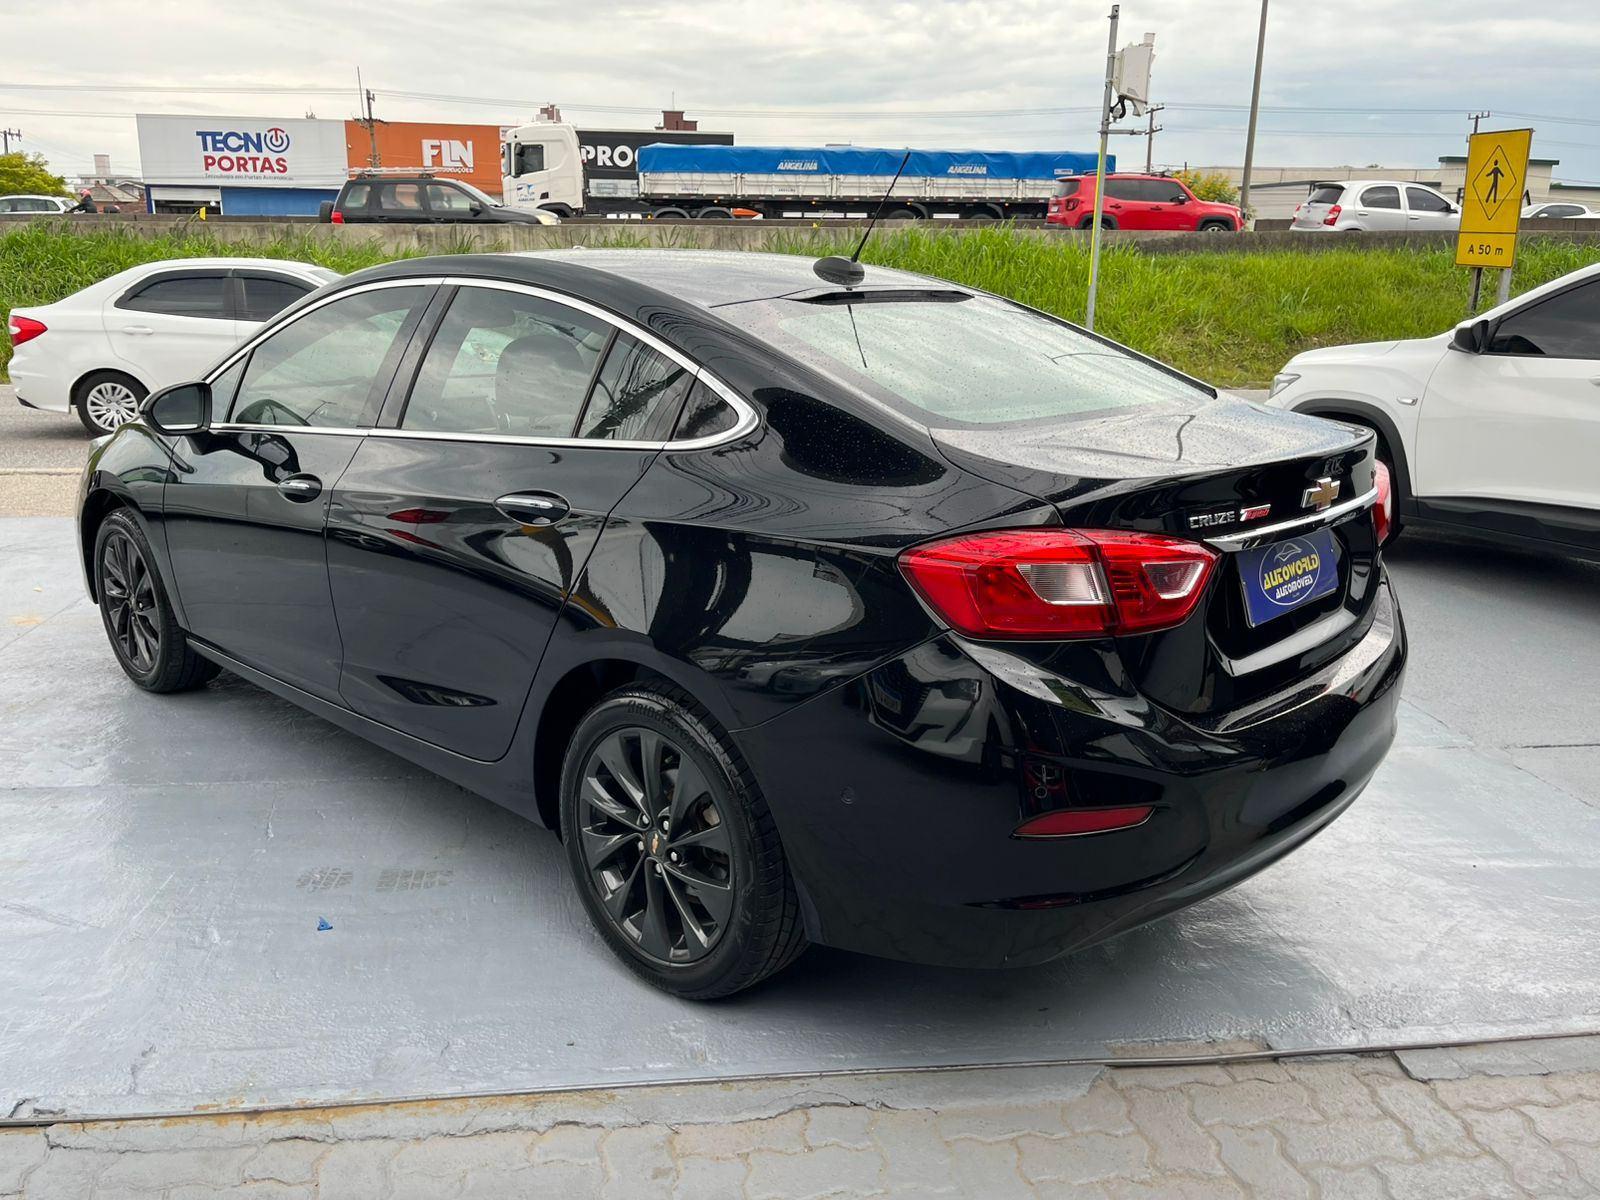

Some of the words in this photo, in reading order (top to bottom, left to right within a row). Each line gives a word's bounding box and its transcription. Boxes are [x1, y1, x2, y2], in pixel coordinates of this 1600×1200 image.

[204, 155, 288, 173] PORTAS
[580, 145, 639, 167] PRO
[777, 161, 818, 171] ANGELINA
[947, 165, 987, 174] ANGELINA
[1468, 244, 1475, 255] A
[1478, 244, 1492, 255] 50
[1494, 247, 1504, 256] m
[1189, 510, 1236, 529] CRUZE
[1264, 553, 1319, 590] AUTOWORLD
